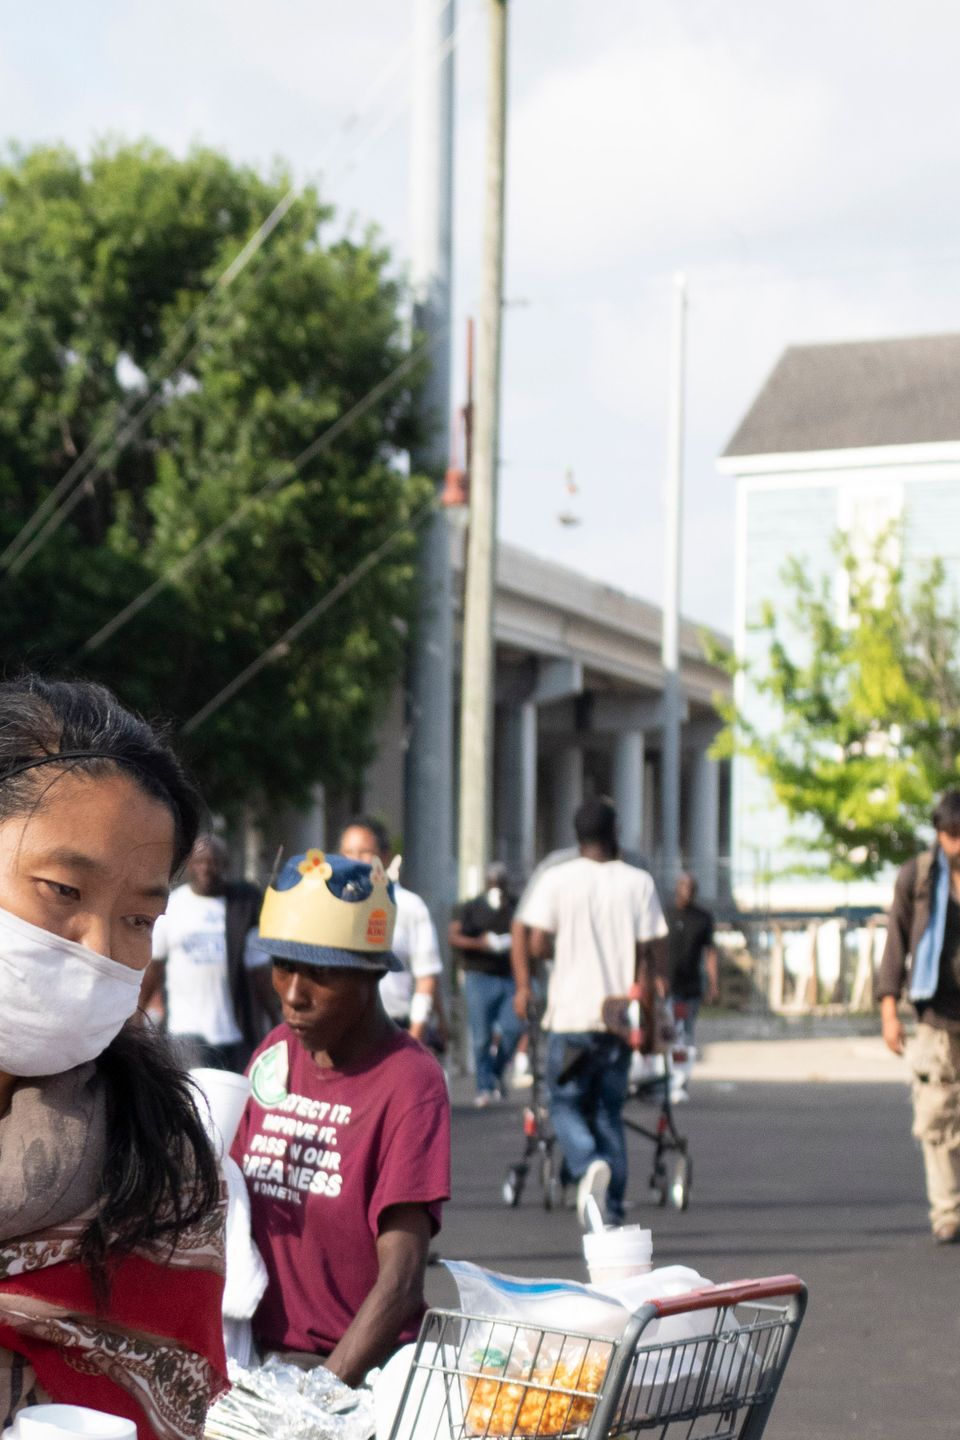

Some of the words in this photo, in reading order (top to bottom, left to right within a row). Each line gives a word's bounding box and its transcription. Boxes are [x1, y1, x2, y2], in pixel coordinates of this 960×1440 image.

[329, 1104, 352, 1125] IT.
[318, 1126, 338, 1145] IT.
[250, 1134, 287, 1156] PASS
[303, 1147, 342, 1171] OUR
